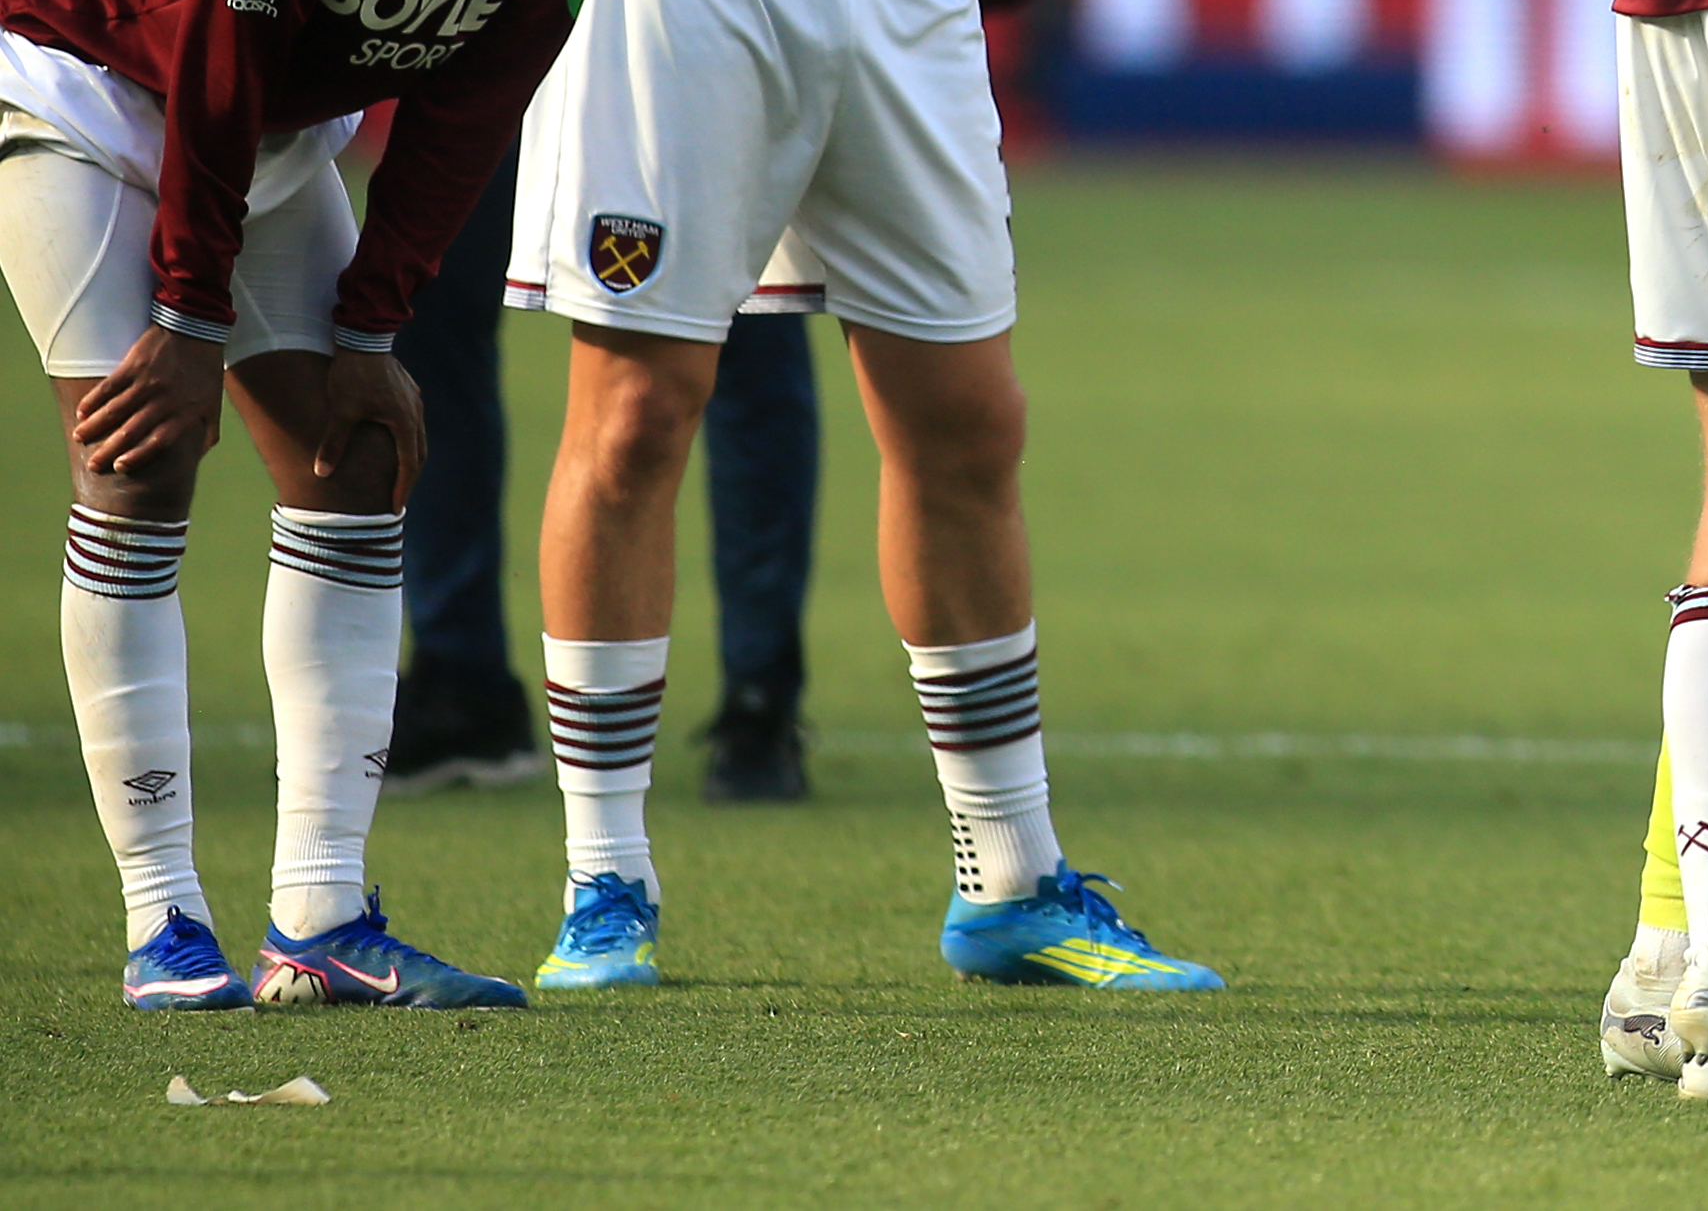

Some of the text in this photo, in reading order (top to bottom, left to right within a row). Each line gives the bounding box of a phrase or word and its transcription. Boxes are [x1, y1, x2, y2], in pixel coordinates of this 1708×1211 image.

[350, 39, 464, 69] SPORT
[601, 218, 659, 236] WEST HAM
[611, 228, 646, 239] UNITED
